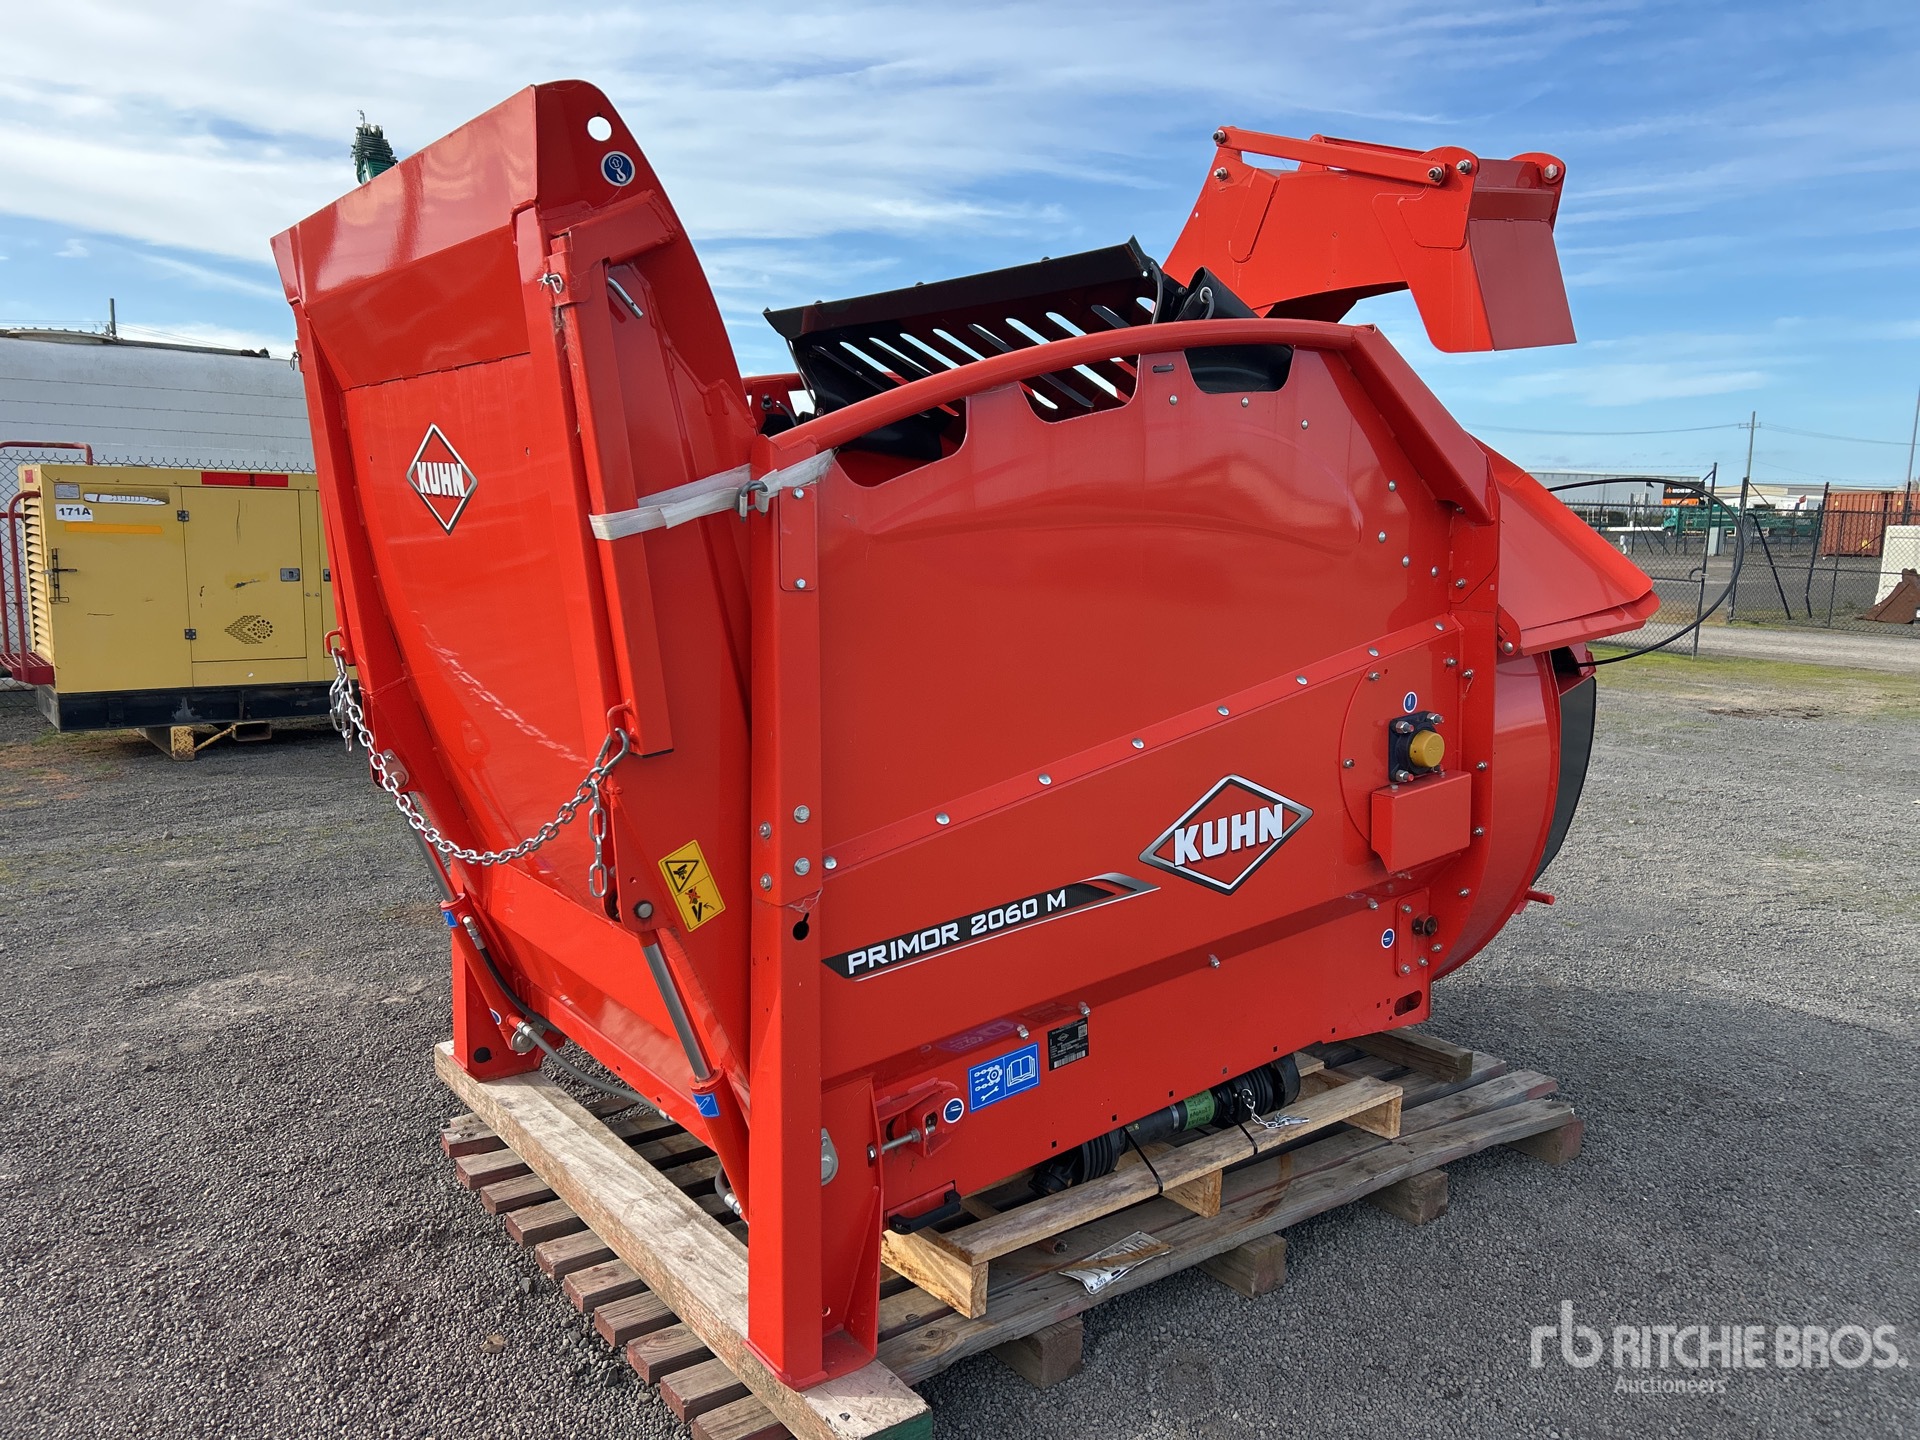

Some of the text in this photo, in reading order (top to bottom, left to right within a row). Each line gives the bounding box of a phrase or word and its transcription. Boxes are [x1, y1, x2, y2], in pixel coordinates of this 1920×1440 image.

[416, 461, 466, 498] KUHN
[59, 507, 91, 516] 171A
[1174, 803, 1283, 867] KUHN
[847, 889, 1066, 975] PRIMOR 2060 M
